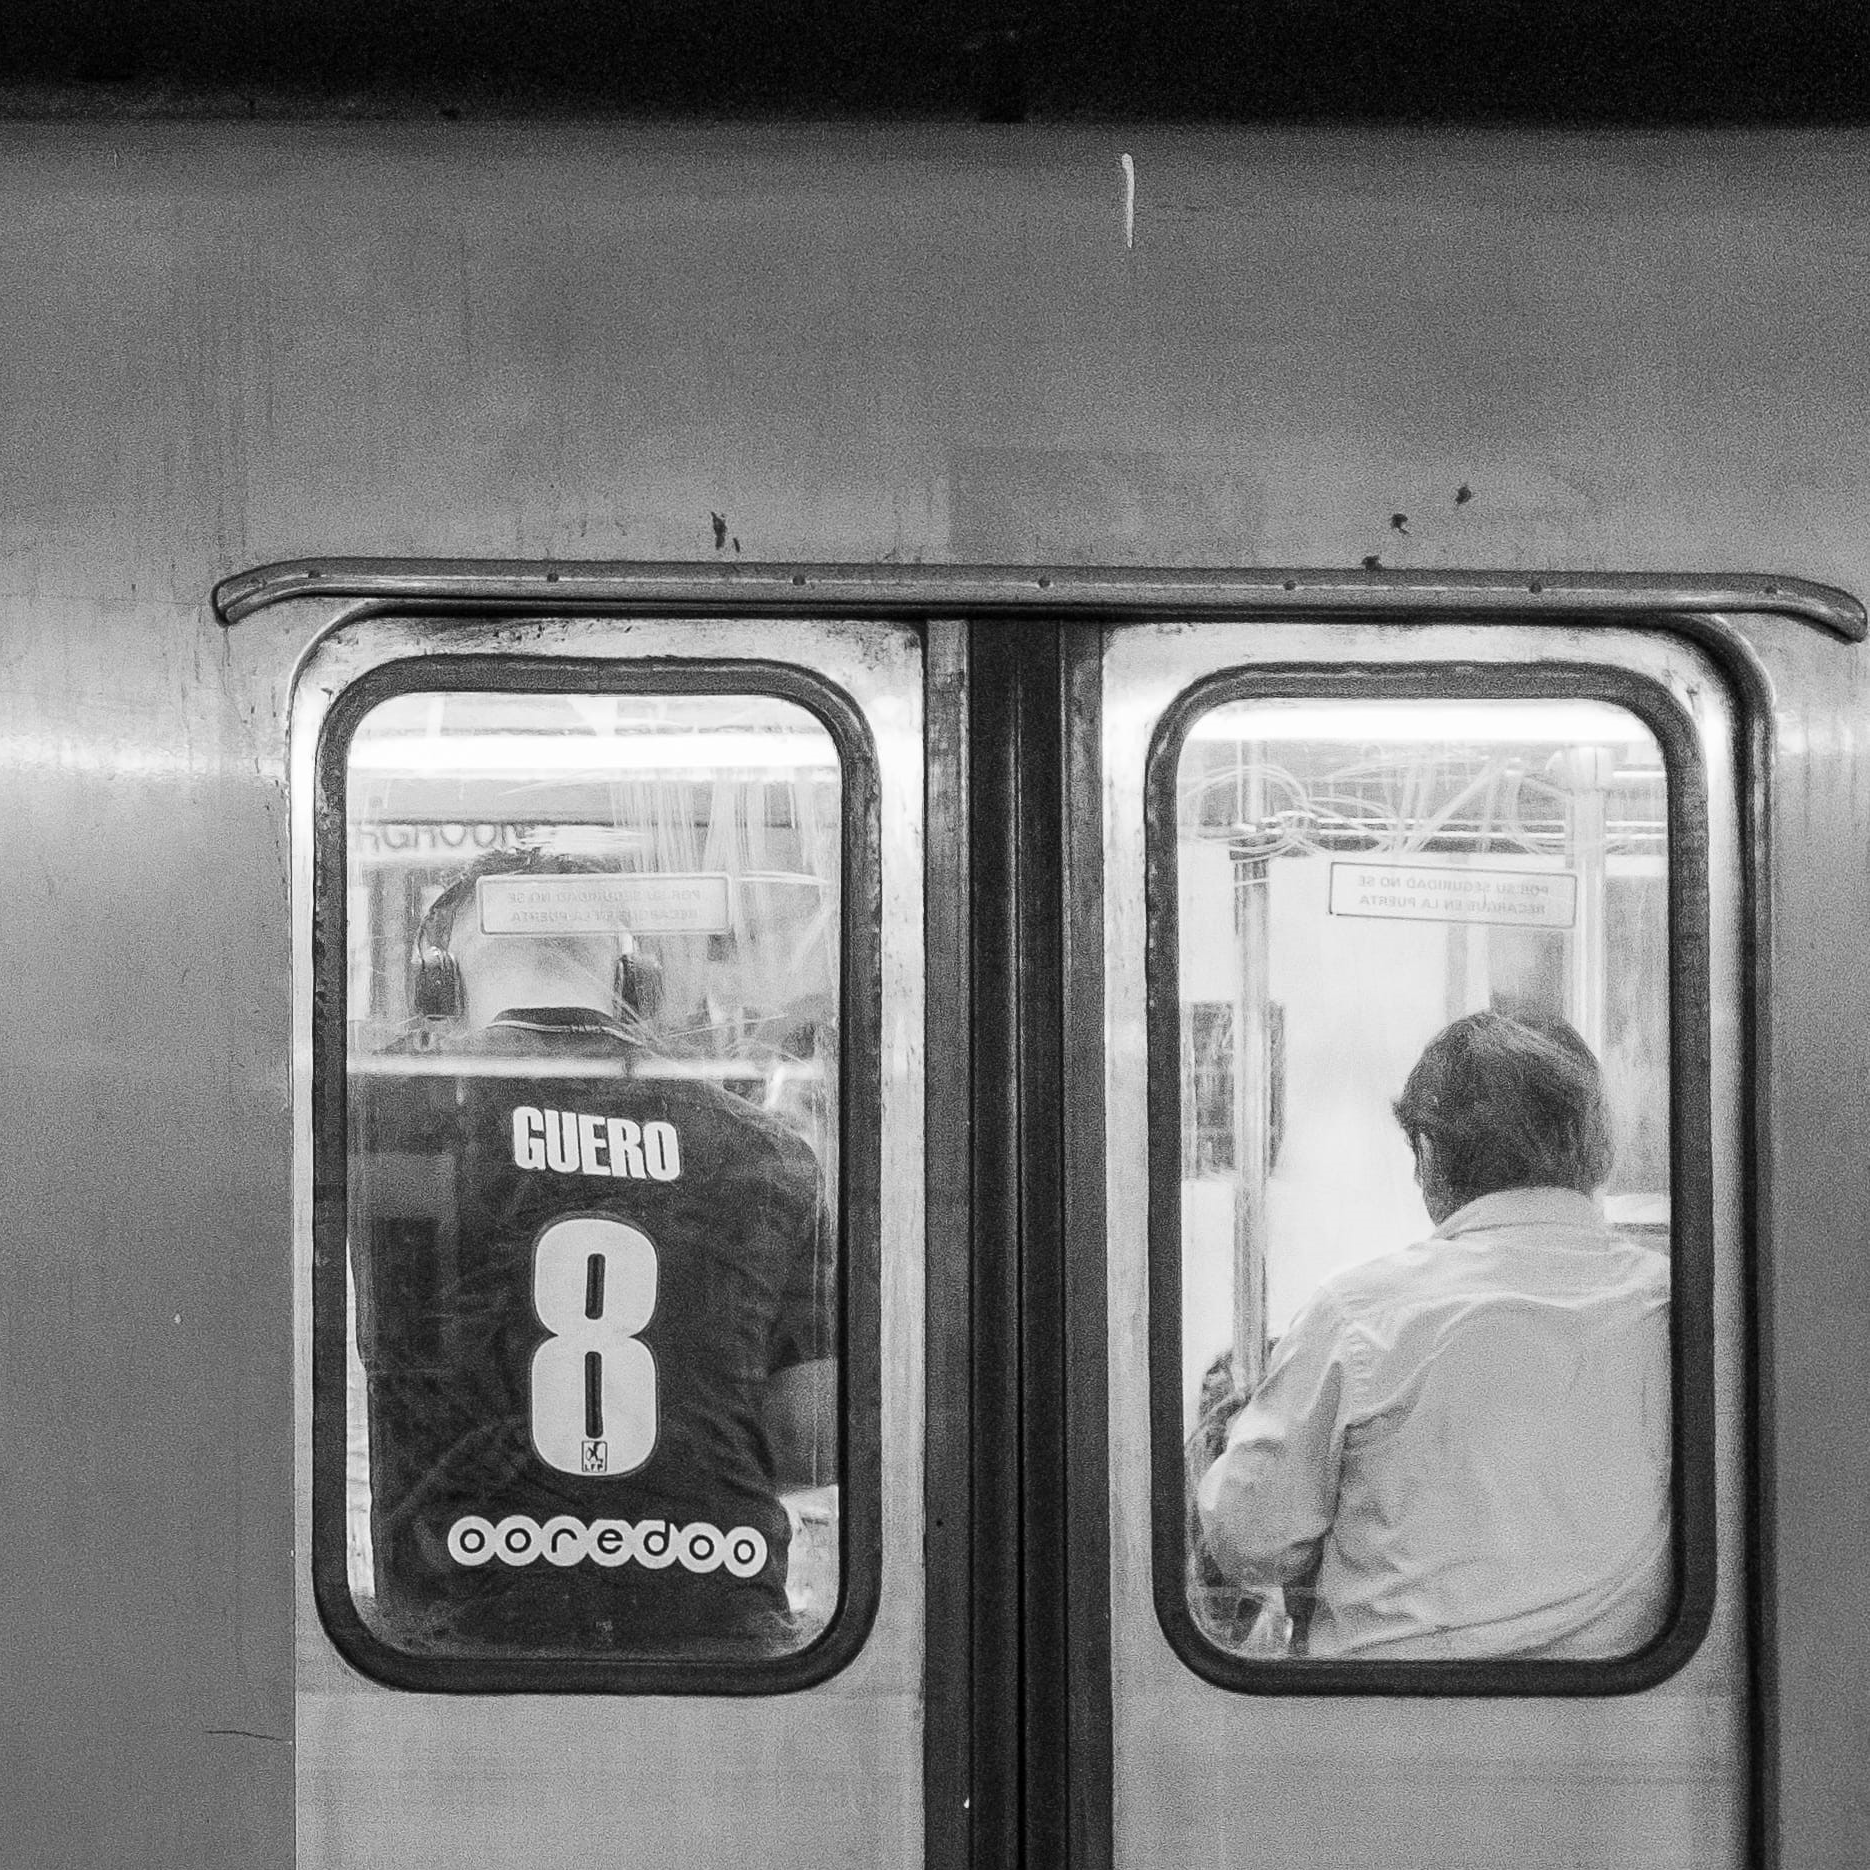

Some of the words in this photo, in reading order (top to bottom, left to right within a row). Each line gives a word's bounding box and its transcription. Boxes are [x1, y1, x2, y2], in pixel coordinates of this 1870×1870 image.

[513, 1106, 680, 1181] GUERO
[531, 1218, 658, 1476] 8
[448, 1515, 767, 1577] ooredoo
